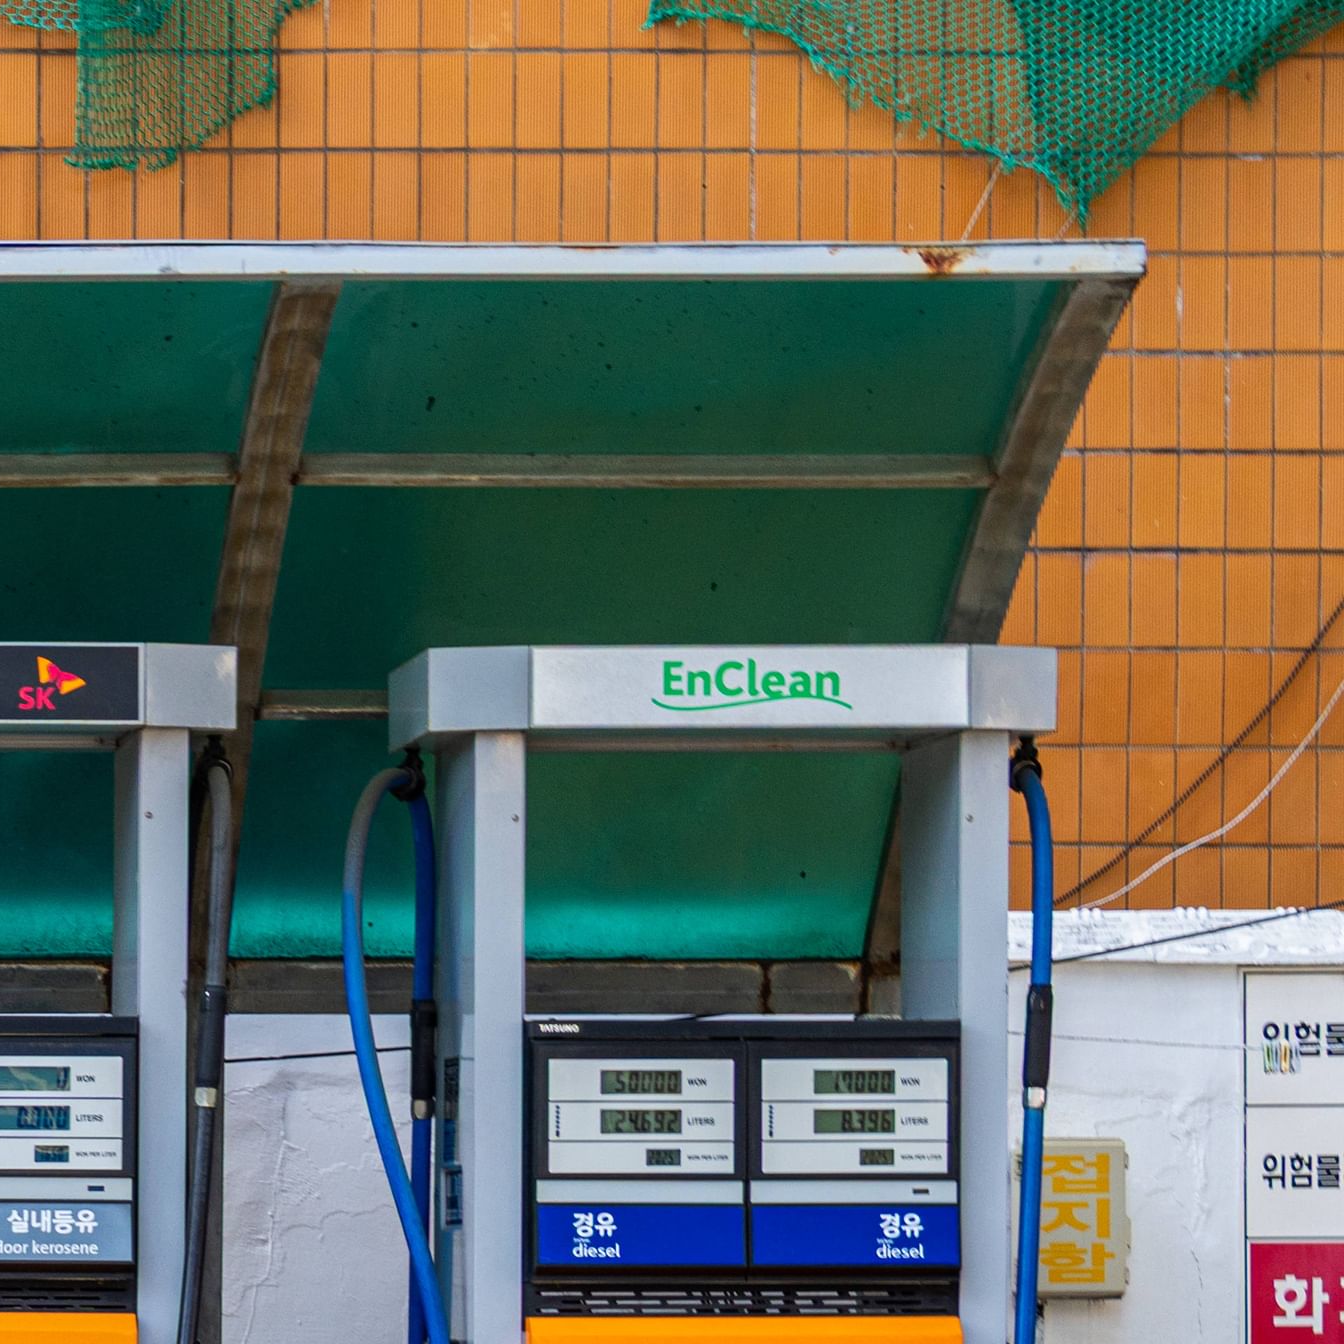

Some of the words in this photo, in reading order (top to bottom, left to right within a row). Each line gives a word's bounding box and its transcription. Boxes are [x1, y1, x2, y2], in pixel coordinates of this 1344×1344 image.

[662, 658, 840, 699] EnClean
[18, 685, 56, 711] SK
[538, 1023, 580, 1033] TATSUNO
[75, 1075, 96, 1083] WON
[615, 1072, 680, 1094] 50000
[687, 1078, 708, 1086] WON
[900, 1077, 921, 1086] WON
[75, 1114, 104, 1123] LITERS
[687, 1118, 715, 1126] LITERS
[900, 1118, 929, 1126] LITERS
[1262, 1153, 1341, 1189] 위험물
[6, 1209, 98, 1234] 실내등유
[572, 1212, 617, 1238] 경유
[879, 1213, 924, 1239] 경유
[1040, 1153, 1116, 1285] 접지함
[31, 1239, 99, 1255] kerosene
[572, 1242, 621, 1259] diesel
[876, 1243, 925, 1260] diesel
[1272, 1274, 1344, 1335] 화
